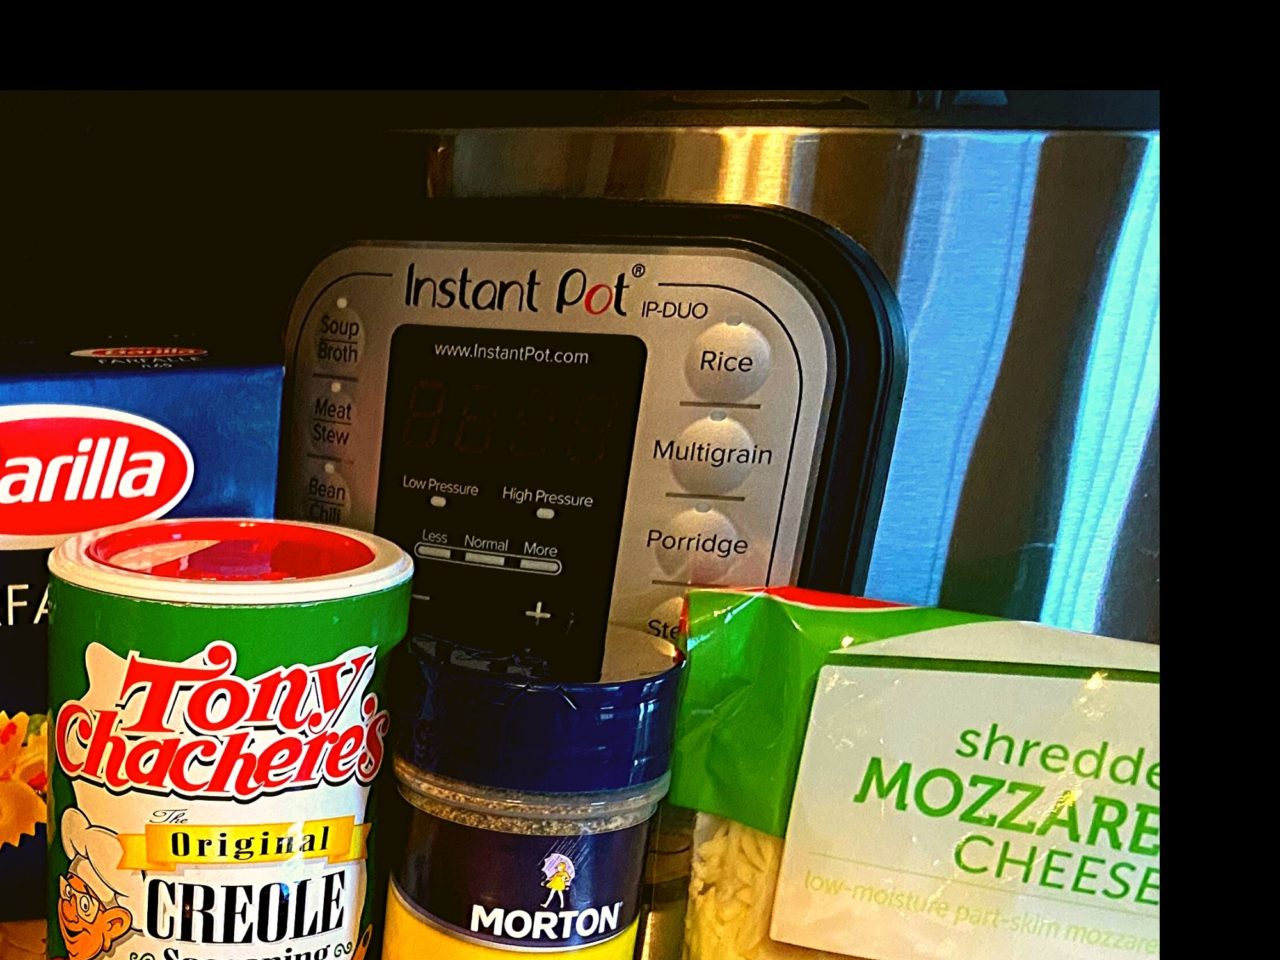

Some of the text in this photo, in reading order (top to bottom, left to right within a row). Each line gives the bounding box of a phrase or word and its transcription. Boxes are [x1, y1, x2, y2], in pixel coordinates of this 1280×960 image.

[404, 263, 708, 320] Instant Pot IP-DUO
[320, 315, 360, 338] Soup
[318, 342, 358, 362] Broth
[434, 342, 590, 364] www.InstantPot.com
[699, 350, 754, 373] Rice
[315, 399, 352, 420] Meat
[313, 424, 350, 445] Stew
[652, 440, 773, 469] Multigrain
[308, 478, 345, 500] Bean
[402, 475, 479, 498] Low Pressure
[502, 487, 594, 509] High Pressure
[309, 503, 341, 524] Chili
[421, 529, 448, 544] Less
[464, 534, 509, 552] Normal
[646, 528, 749, 557] Porridge
[523, 543, 558, 557] More
[122, 644, 378, 734] Tony
[55, 692, 390, 797] Chachere's
[150, 809, 188, 825] The
[171, 826, 329, 862] Original
[954, 835, 1160, 905] CHEESE
[147, 871, 346, 945] CREOLE
[804, 870, 949, 917] low-moisture
[954, 905, 1061, 939] part-skim
[470, 904, 619, 940] MORTON
